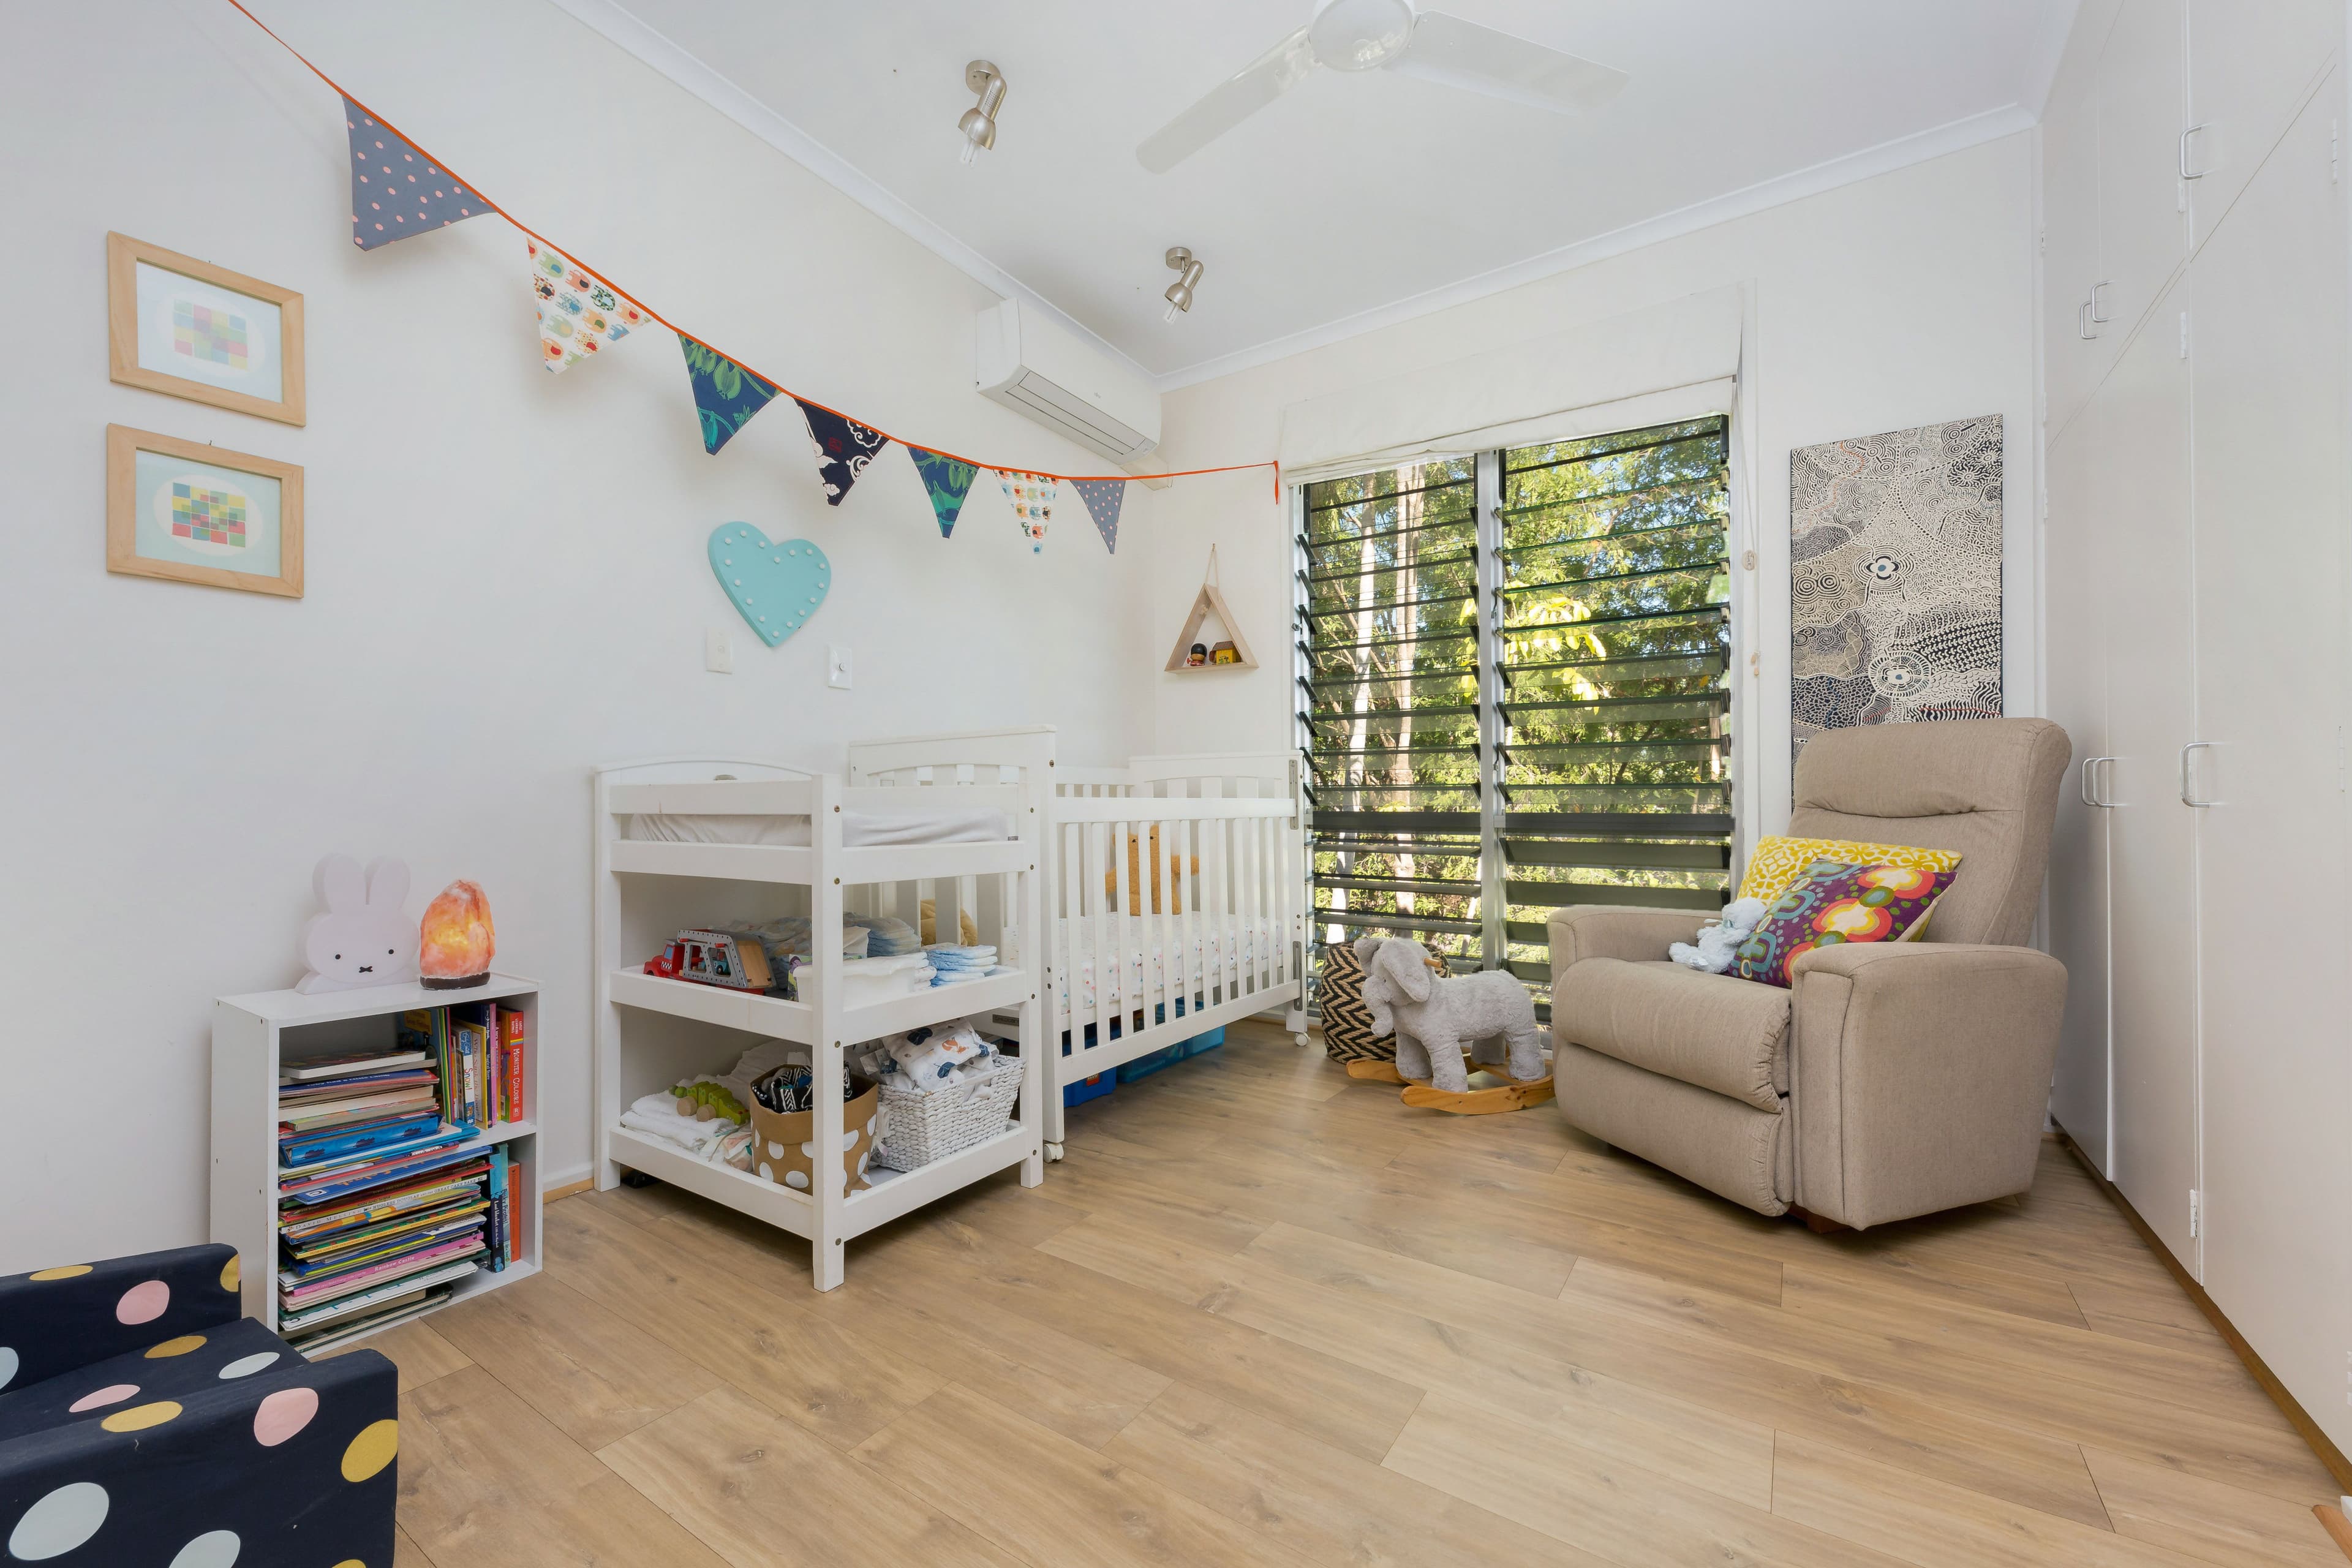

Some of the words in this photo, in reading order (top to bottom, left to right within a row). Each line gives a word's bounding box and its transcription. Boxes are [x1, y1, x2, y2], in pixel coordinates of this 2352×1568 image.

[464, 1068, 473, 1090] Snow!
[296, 1219, 321, 1230] DAVID
[326, 1208, 361, 1221] MELLING
[397, 1194, 420, 1204] DOUGLAS
[374, 1261, 396, 1272] Rainbow
[398, 1256, 415, 1265] Castle
